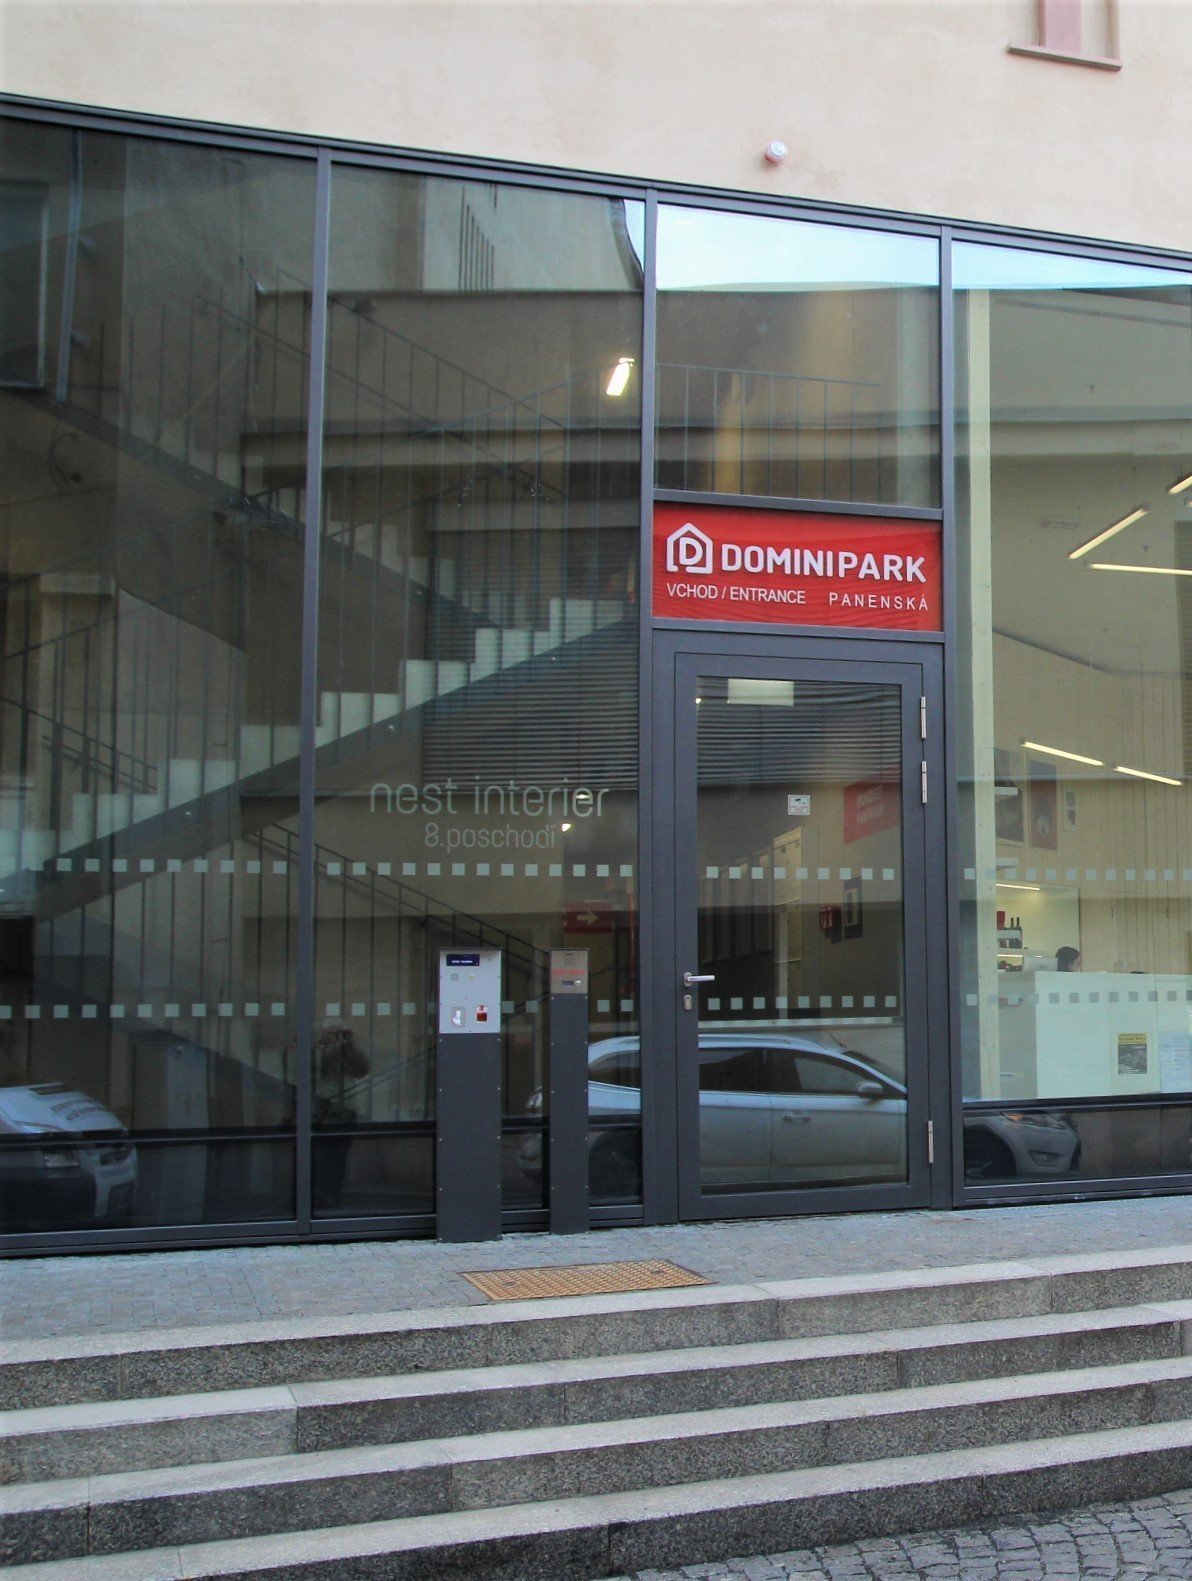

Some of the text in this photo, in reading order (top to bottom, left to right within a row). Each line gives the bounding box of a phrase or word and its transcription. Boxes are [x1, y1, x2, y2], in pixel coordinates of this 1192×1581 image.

[721, 543, 927, 583] DOMINIPARK
[666, 582, 718, 600] VCHOD
[729, 586, 806, 604] ENTRANCE
[829, 592, 929, 611] PANENSKÁ
[369, 775, 609, 818] nest interier
